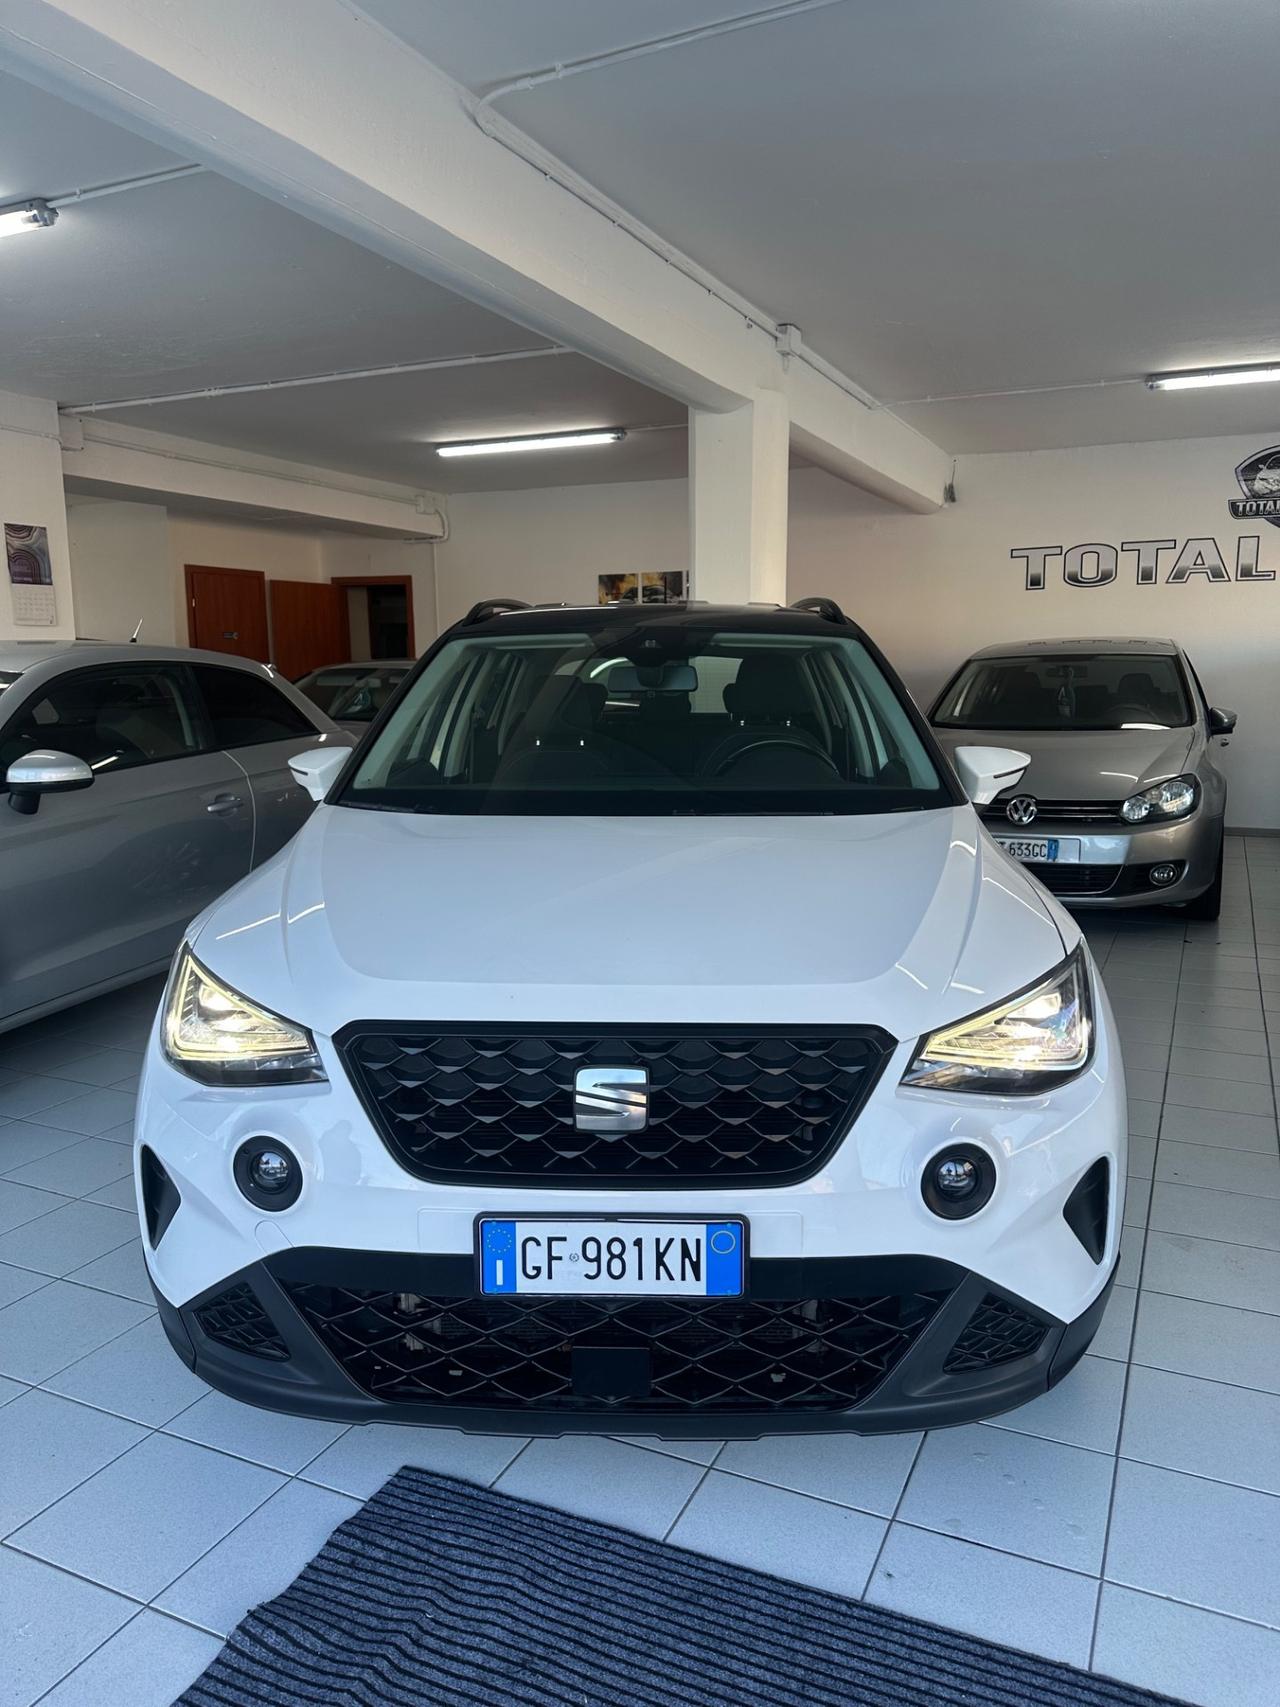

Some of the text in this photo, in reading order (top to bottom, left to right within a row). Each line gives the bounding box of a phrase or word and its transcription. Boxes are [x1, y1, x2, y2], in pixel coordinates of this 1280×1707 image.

[1011, 535, 1276, 590] TOTAL
[1009, 841, 1047, 858] 633GC
[521, 1236, 702, 1281] GF 981KN
